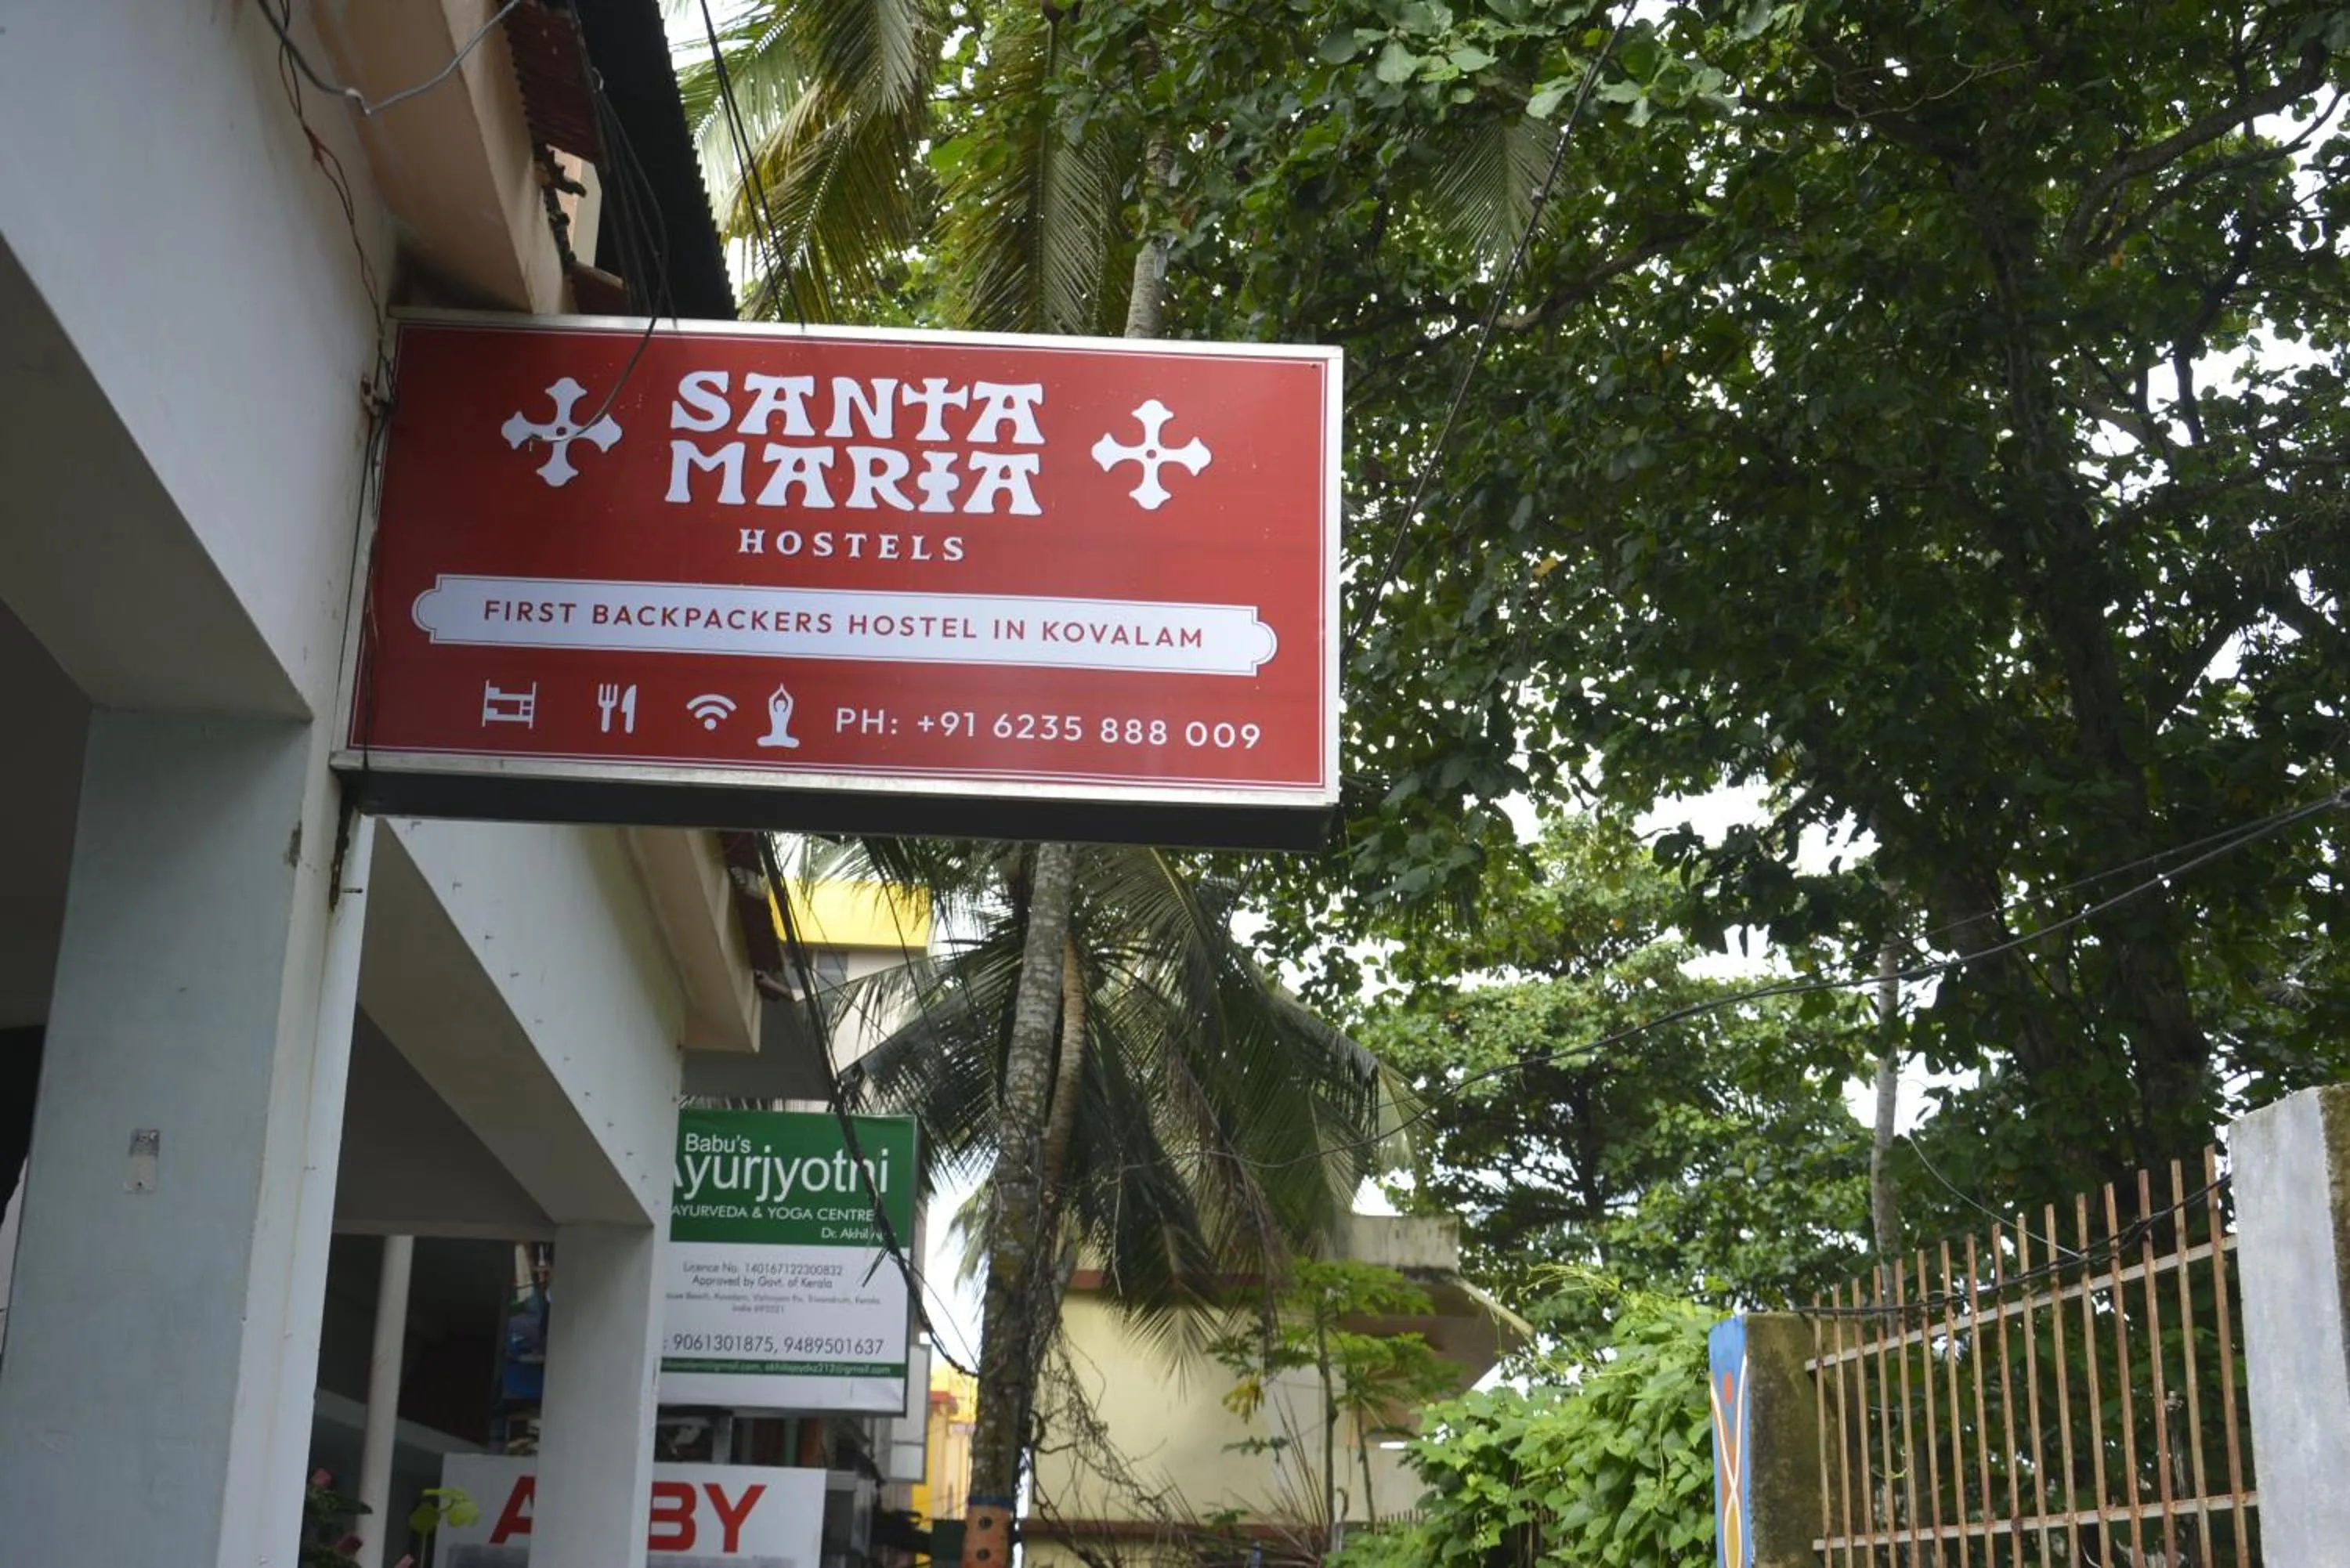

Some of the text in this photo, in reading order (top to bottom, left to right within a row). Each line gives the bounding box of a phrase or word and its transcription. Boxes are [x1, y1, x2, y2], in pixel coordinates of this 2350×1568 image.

[670, 370, 1045, 445] SANTA
[664, 439, 1043, 515] MARIA
[739, 528, 965, 562] HOSTELS
[483, 599, 1203, 649] FIRST BACKPACKERS HOSTEL IN KOVALAM
[835, 706, 1261, 750] PH: +91 6235 888 009
[685, 1133, 752, 1154] Babu's
[674, 1144, 889, 1203] yurjyothi
[671, 1204, 874, 1222] AYURVEDA & YOGA CENTRE
[743, 1277, 754, 1288] by
[787, 1277, 799, 1288] of
[801, 1278, 833, 1288] Kerala
[674, 1333, 779, 1354] 9061301875,
[783, 1336, 884, 1356] 9489501637
